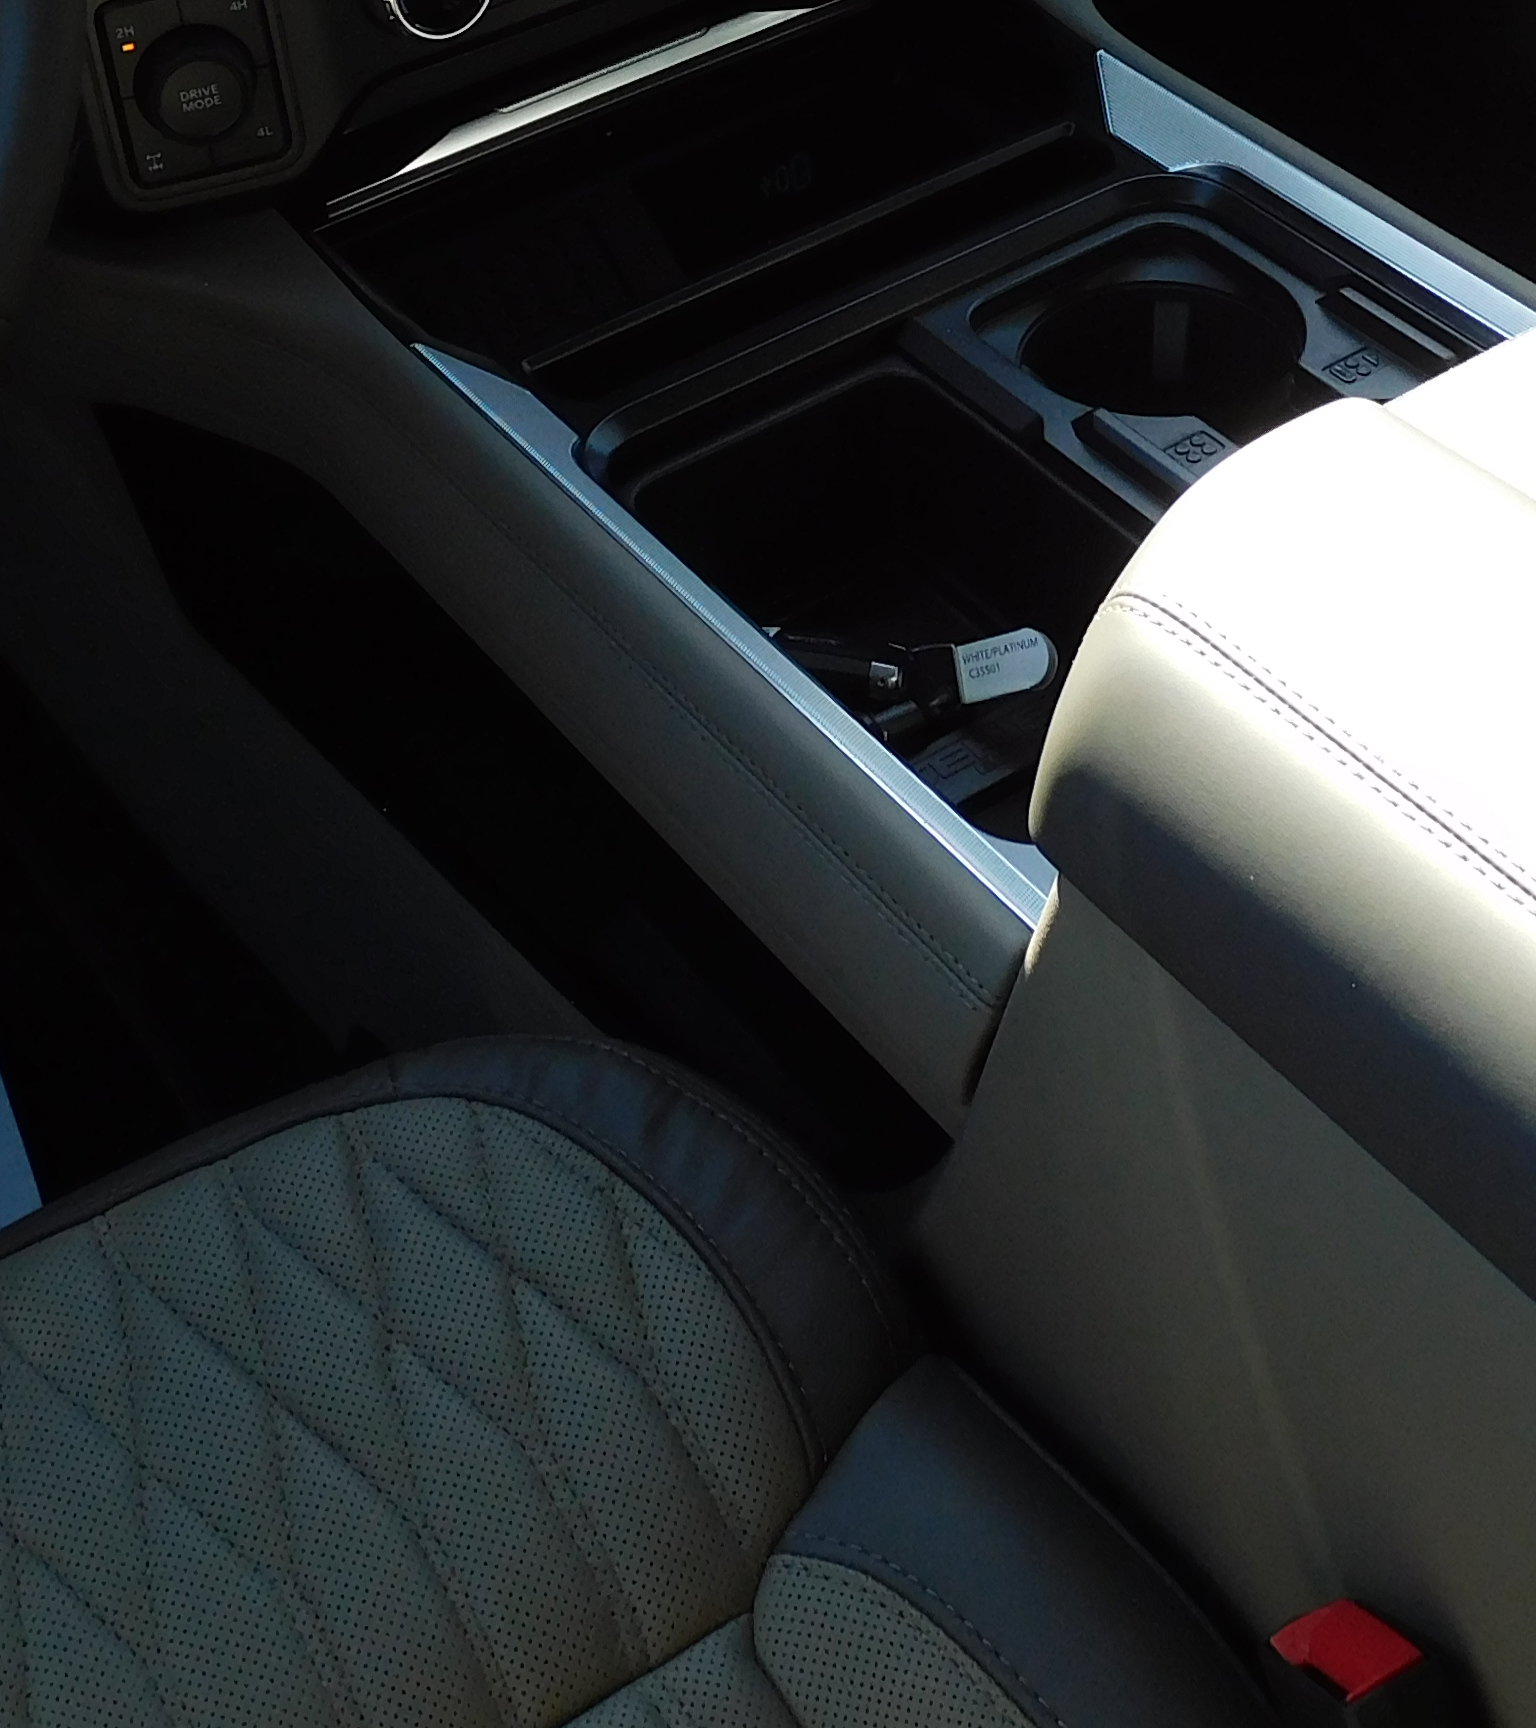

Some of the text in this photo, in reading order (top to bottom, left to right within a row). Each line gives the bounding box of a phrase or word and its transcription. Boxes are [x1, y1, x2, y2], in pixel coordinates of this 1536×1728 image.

[229, 0, 248, 11] 4H
[116, 26, 134, 39] 2H
[179, 83, 219, 102] DRIVE
[182, 94, 222, 112] MODE
[257, 125, 273, 137] 4L
[962, 637, 1038, 665] WHITE/PLATINUM
